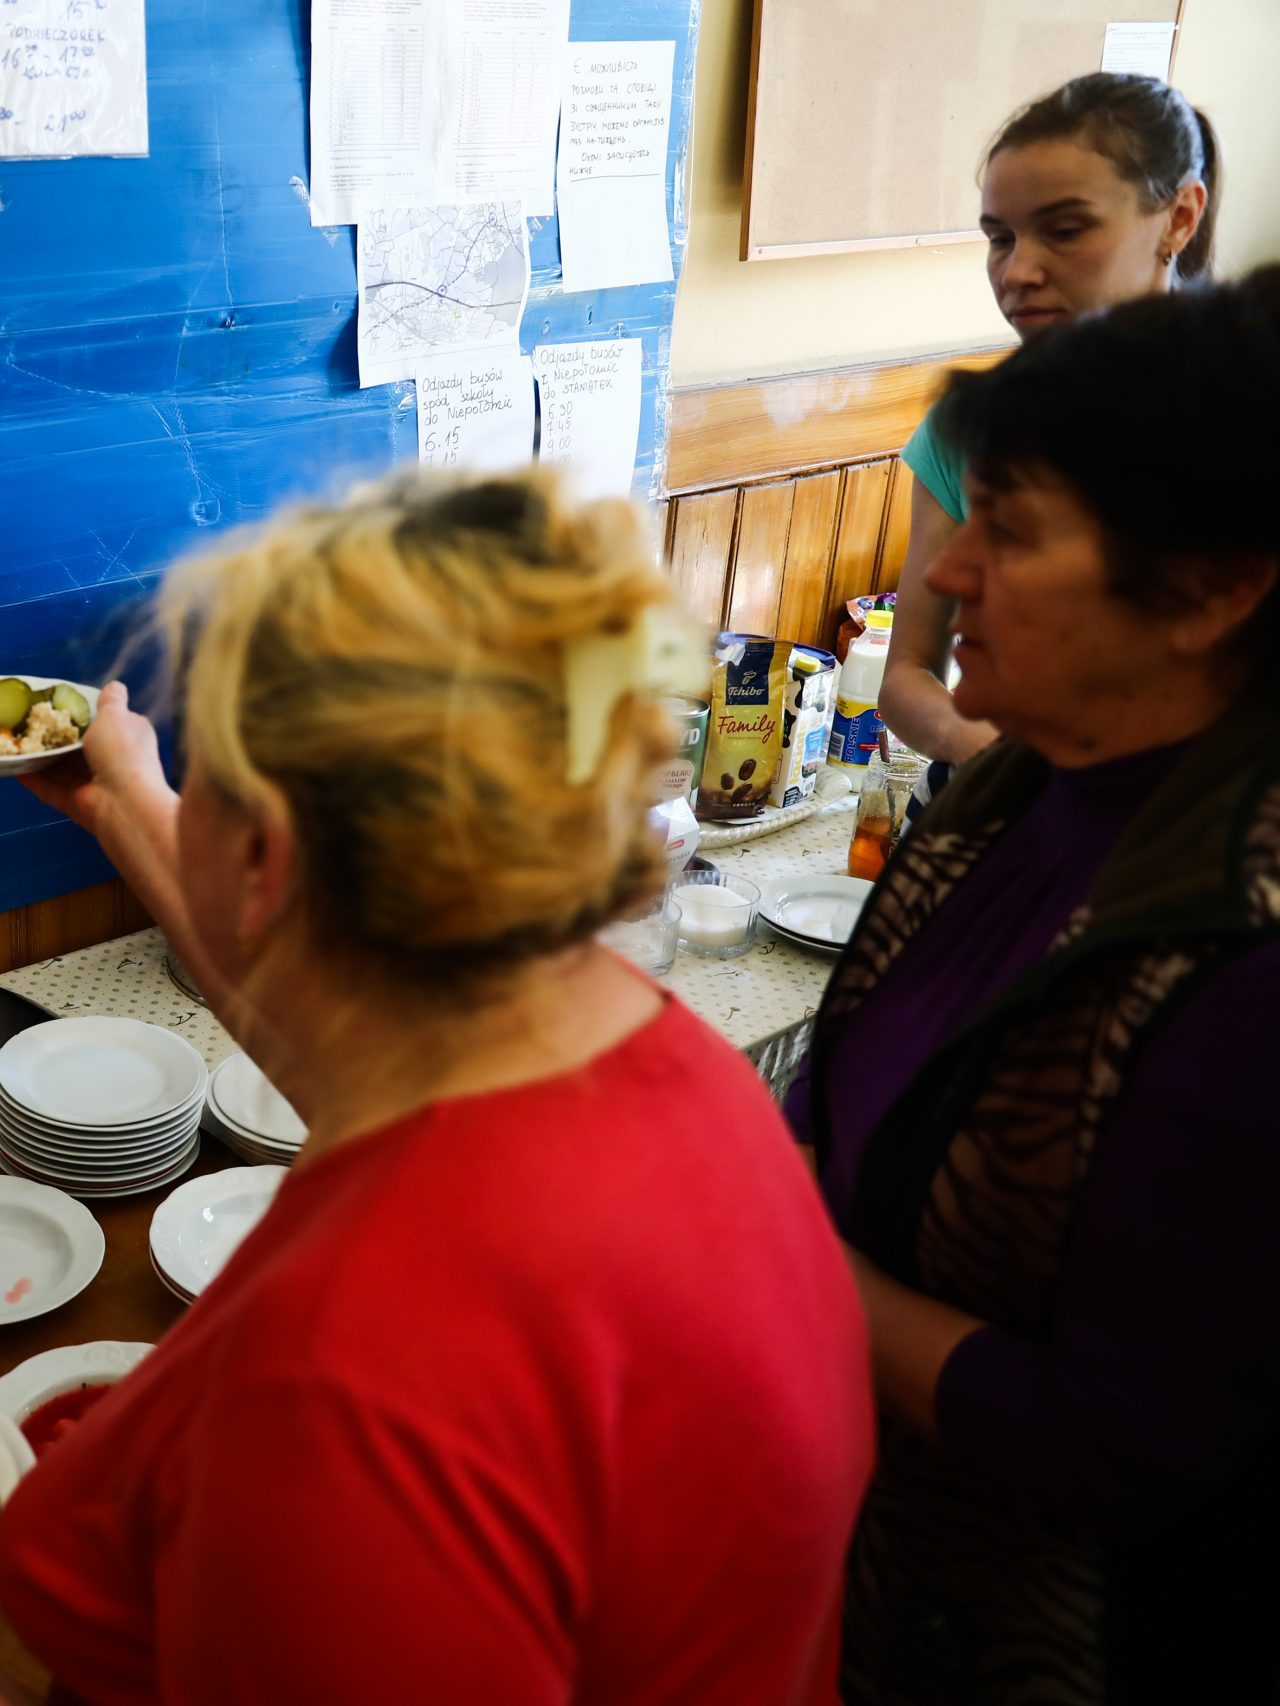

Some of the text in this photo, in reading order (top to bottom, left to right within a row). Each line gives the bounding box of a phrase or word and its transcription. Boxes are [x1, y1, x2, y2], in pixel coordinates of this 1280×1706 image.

[540, 346, 585, 369] Odjazdy
[422, 367, 503, 398] Odjazdy busów
[543, 385, 556, 400] do
[459, 383, 494, 405] szkoły
[424, 409, 439, 427] do
[728, 686, 766, 696] Tchibo
[718, 714, 776, 744] Family
[844, 716, 861, 763] POLSKIE
